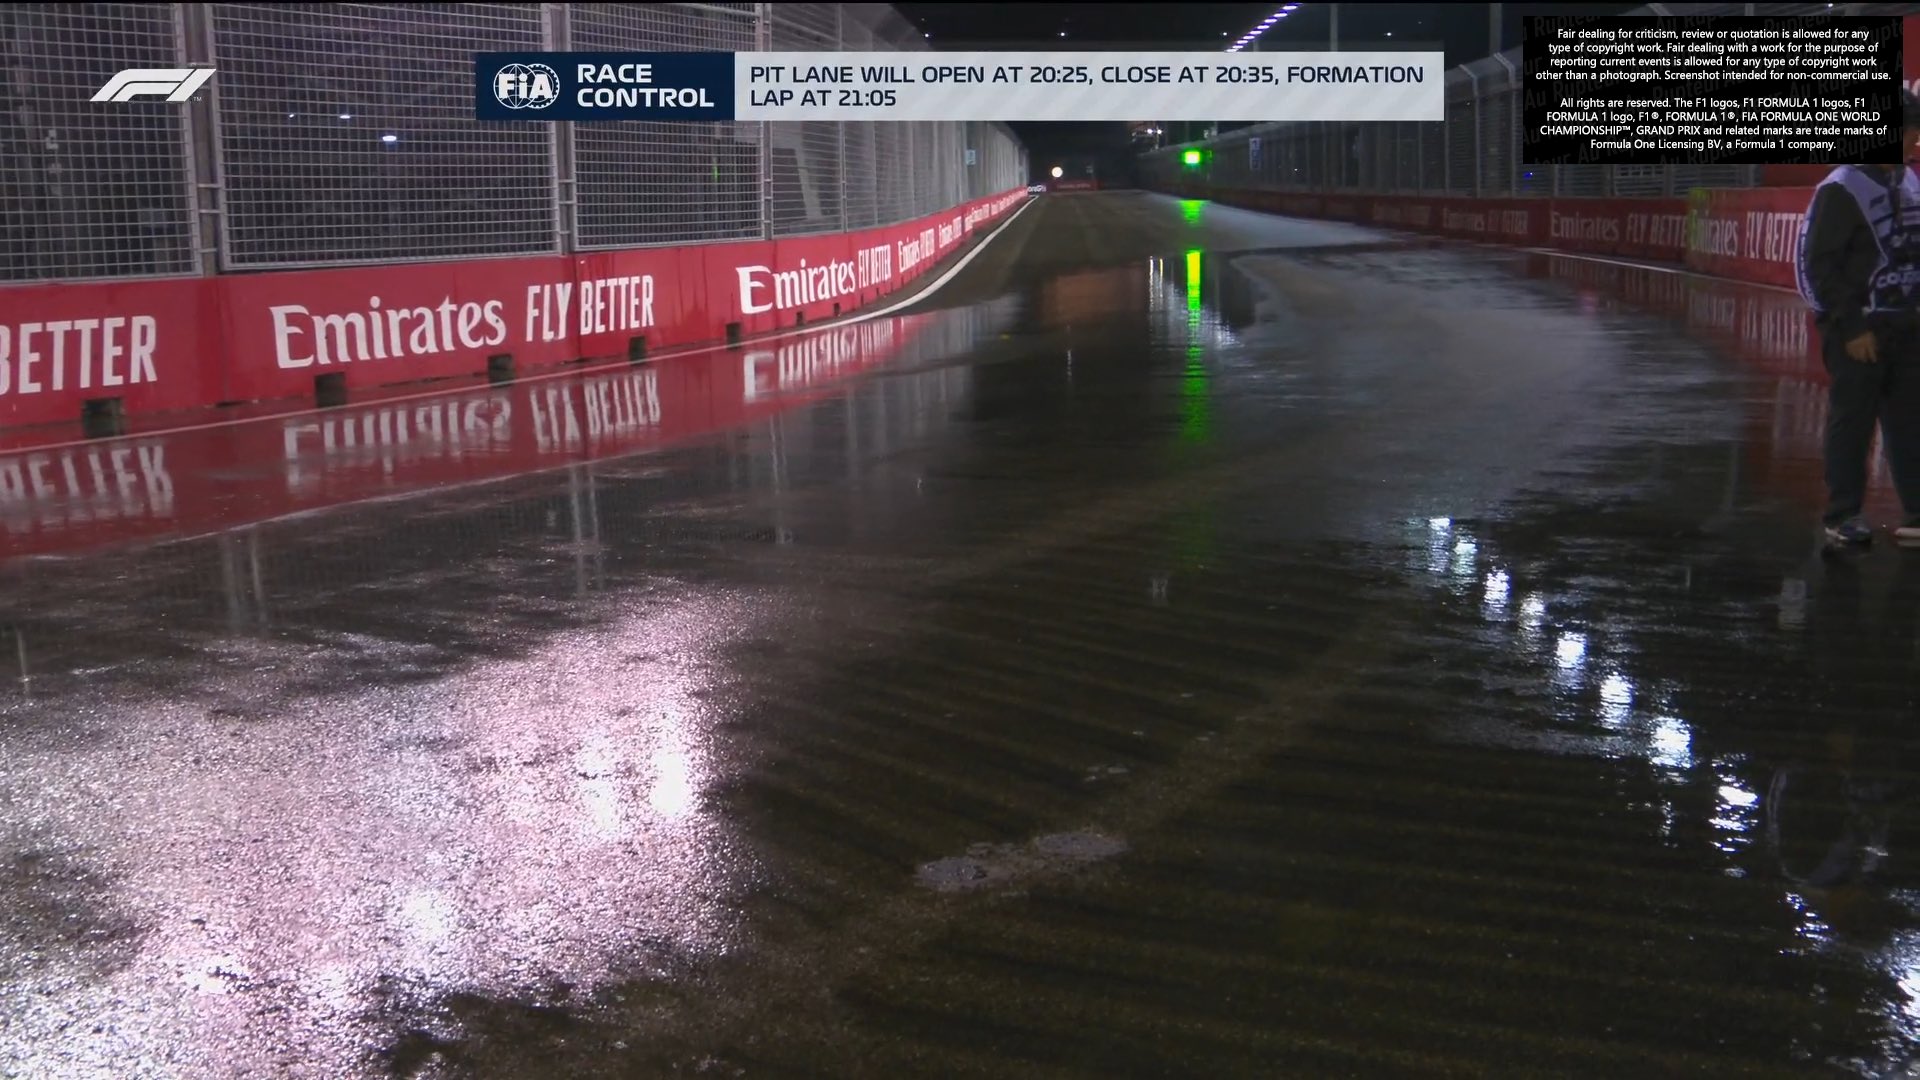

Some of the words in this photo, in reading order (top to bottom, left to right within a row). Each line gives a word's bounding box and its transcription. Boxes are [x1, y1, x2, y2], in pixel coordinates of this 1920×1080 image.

[1550, 210, 1619, 241] Emirates
[1625, 212, 1648, 243] FLY
[1650, 213, 1687, 248] BETTE
[1744, 211, 1765, 259] FLY
[735, 257, 856, 314] Emirates
[269, 295, 507, 369] Emirates
[526, 282, 573, 342] FLY
[580, 274, 655, 336] BETTER
